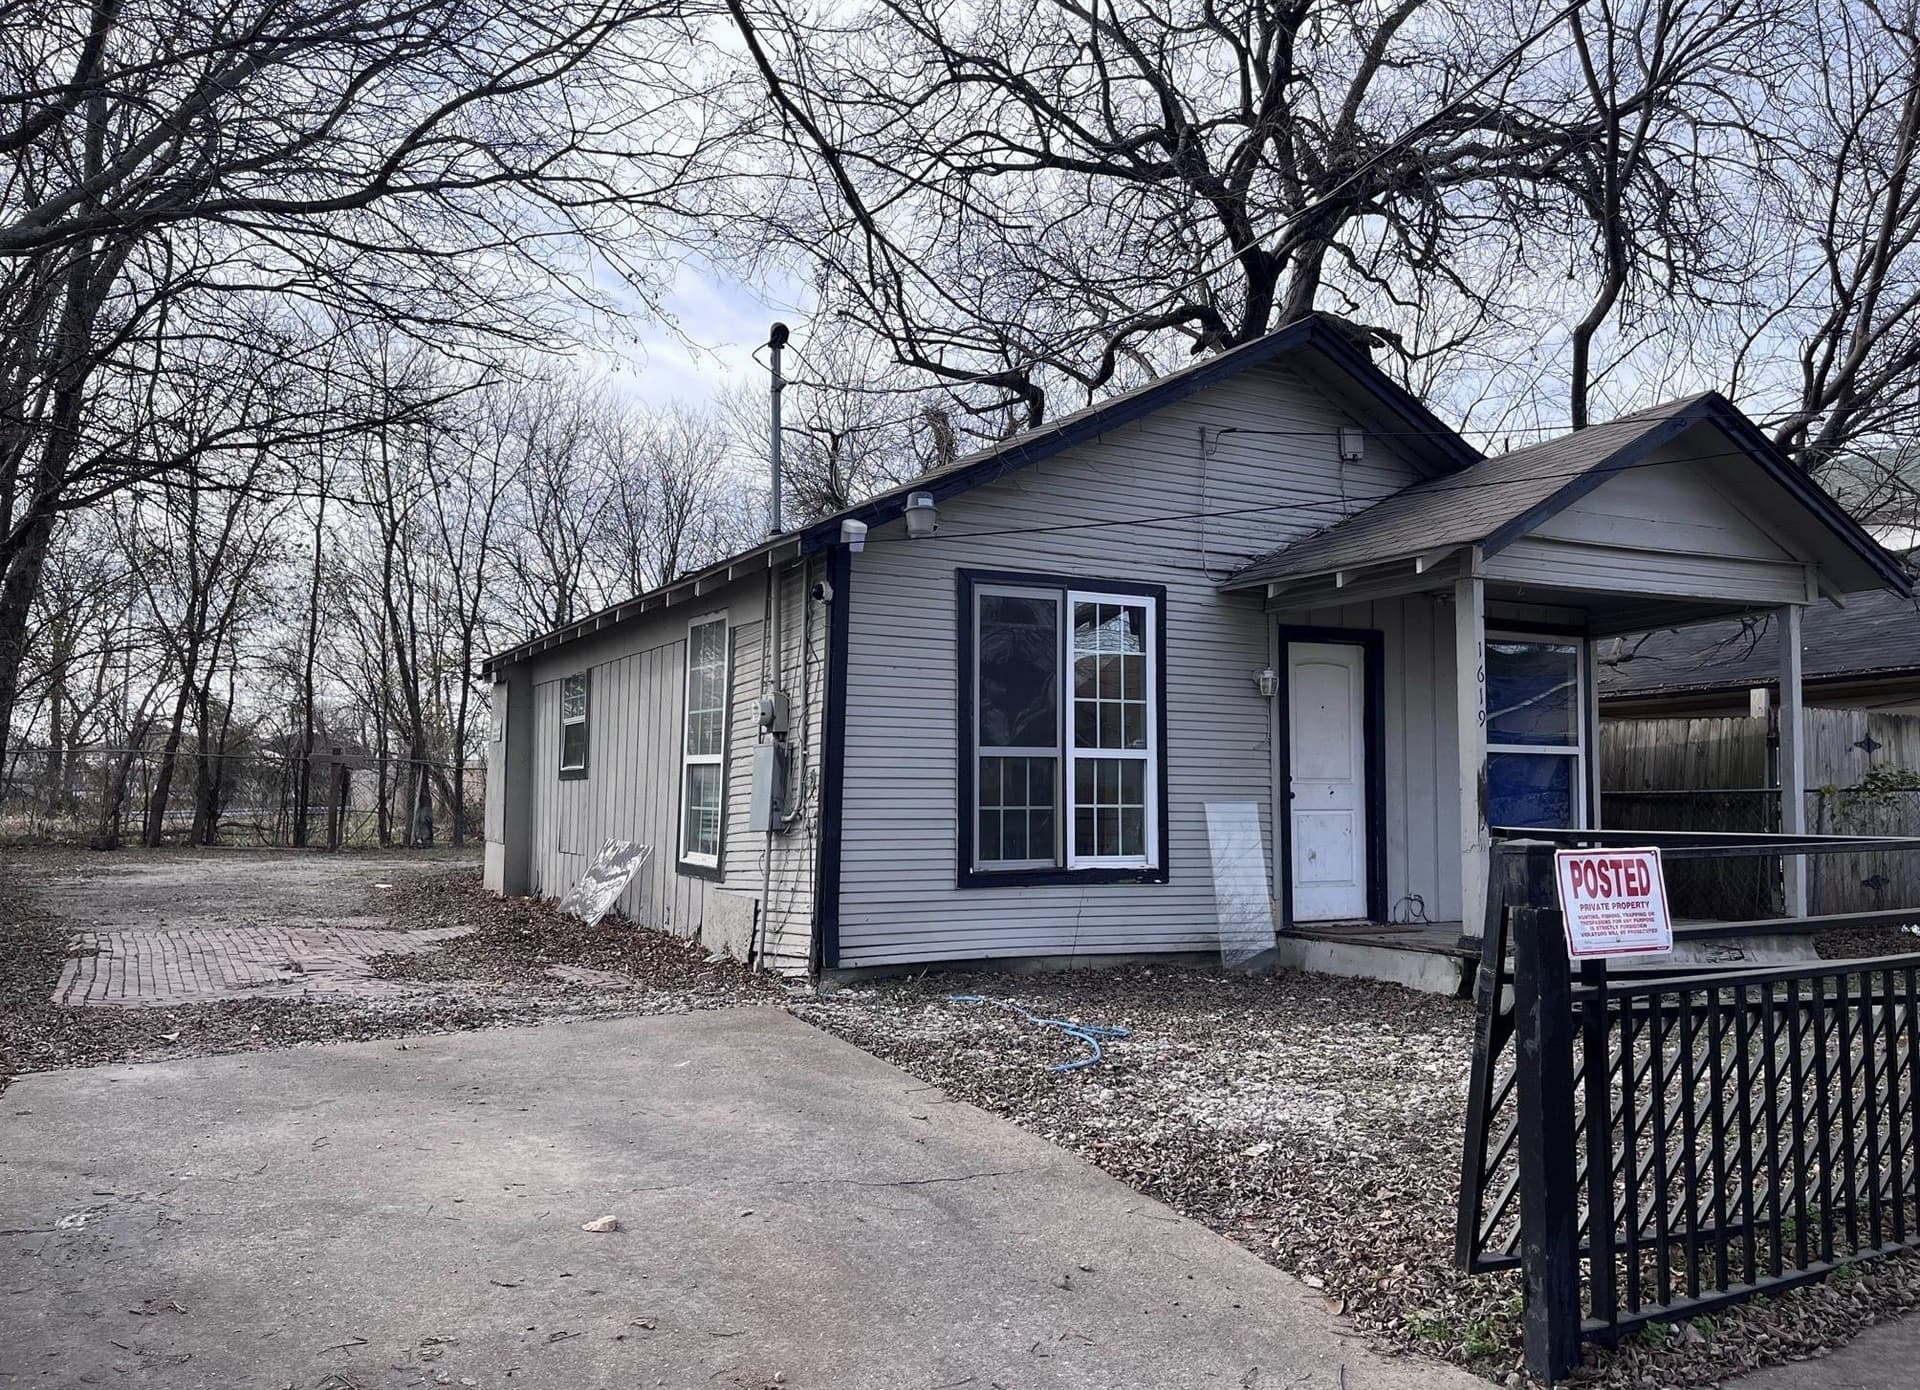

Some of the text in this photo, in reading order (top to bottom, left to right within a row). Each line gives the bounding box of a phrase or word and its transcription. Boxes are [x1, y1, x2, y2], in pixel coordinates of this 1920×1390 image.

[1477, 641, 1486, 727] 1619
[1569, 858, 1651, 899] POSTED
[1580, 901, 1650, 912] PRIVATE PROPERTY
